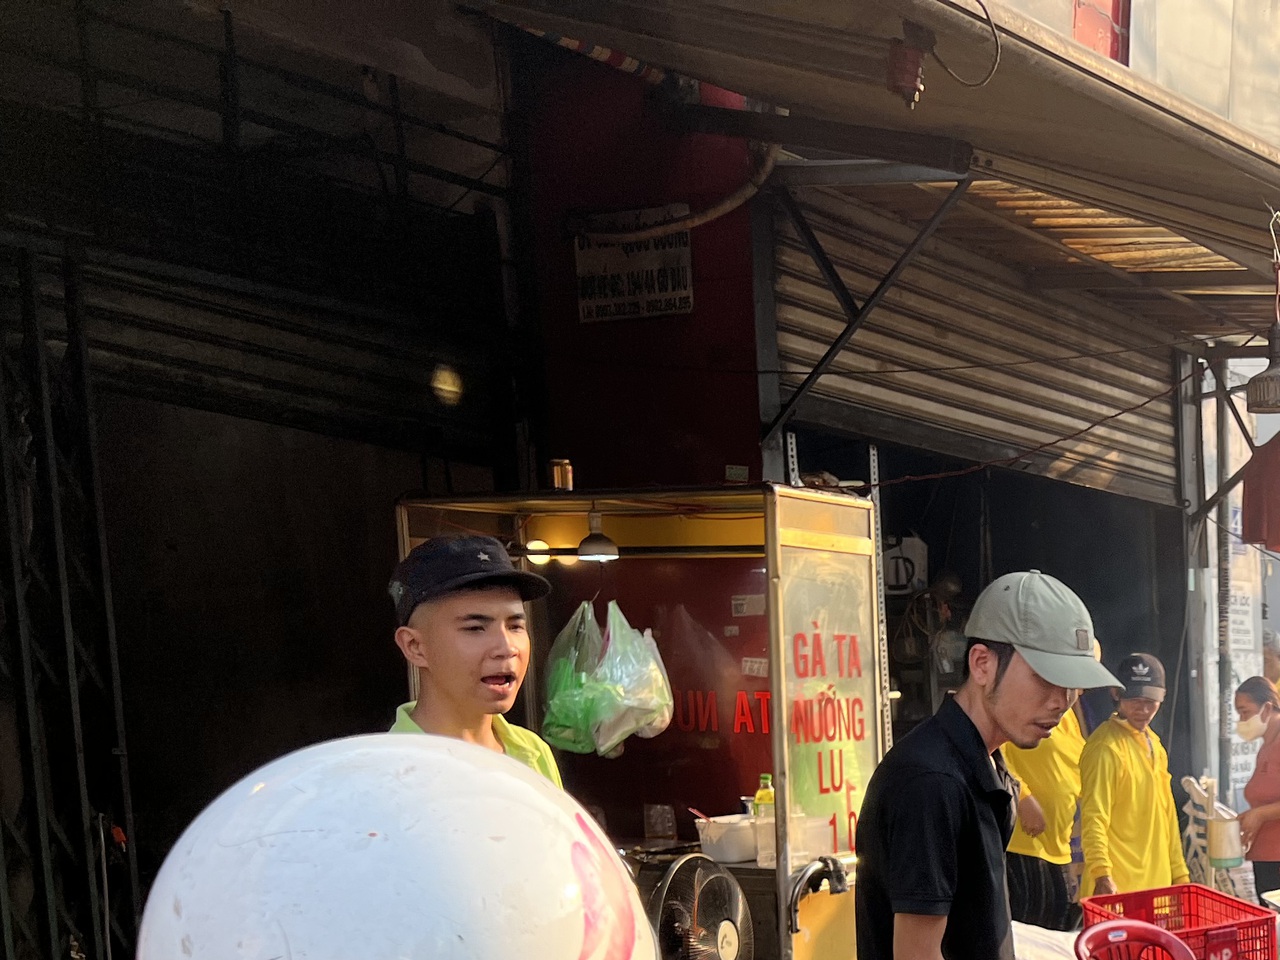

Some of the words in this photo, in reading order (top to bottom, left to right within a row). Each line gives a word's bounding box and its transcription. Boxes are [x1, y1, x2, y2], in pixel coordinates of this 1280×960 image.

[793, 620, 827, 679] GÀ
[832, 634, 862, 678] TA
[792, 684, 865, 744] NƯỚNG
[817, 749, 843, 795] LU
